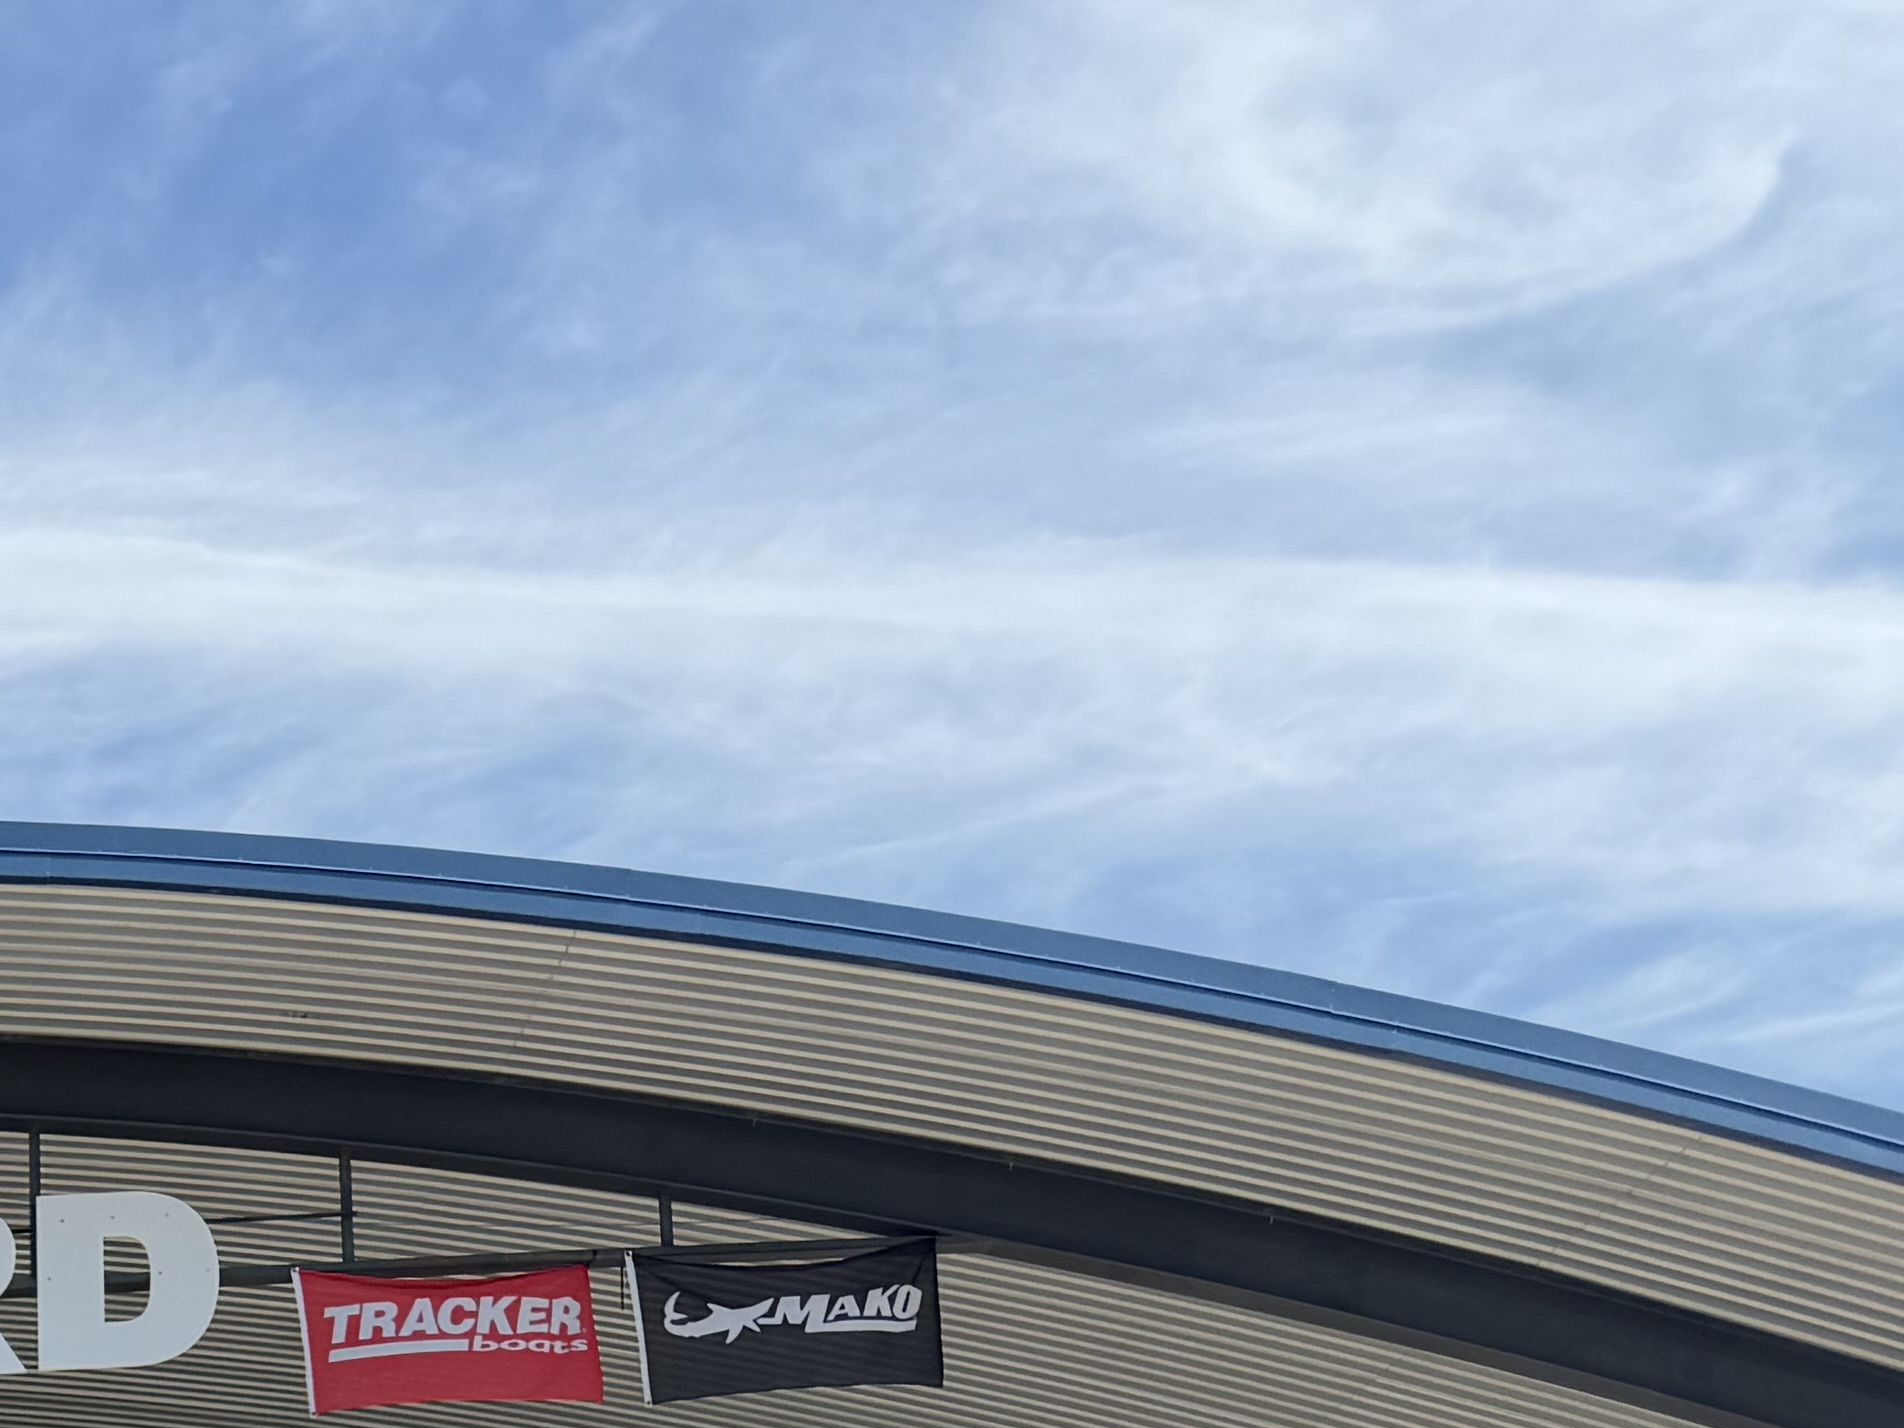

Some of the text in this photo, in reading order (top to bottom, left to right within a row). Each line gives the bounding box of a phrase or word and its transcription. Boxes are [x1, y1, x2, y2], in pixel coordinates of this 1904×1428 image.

[323, 1296, 583, 1344] TRACKER
[764, 1283, 923, 1332] MAKO
[471, 1333, 589, 1354] boats
